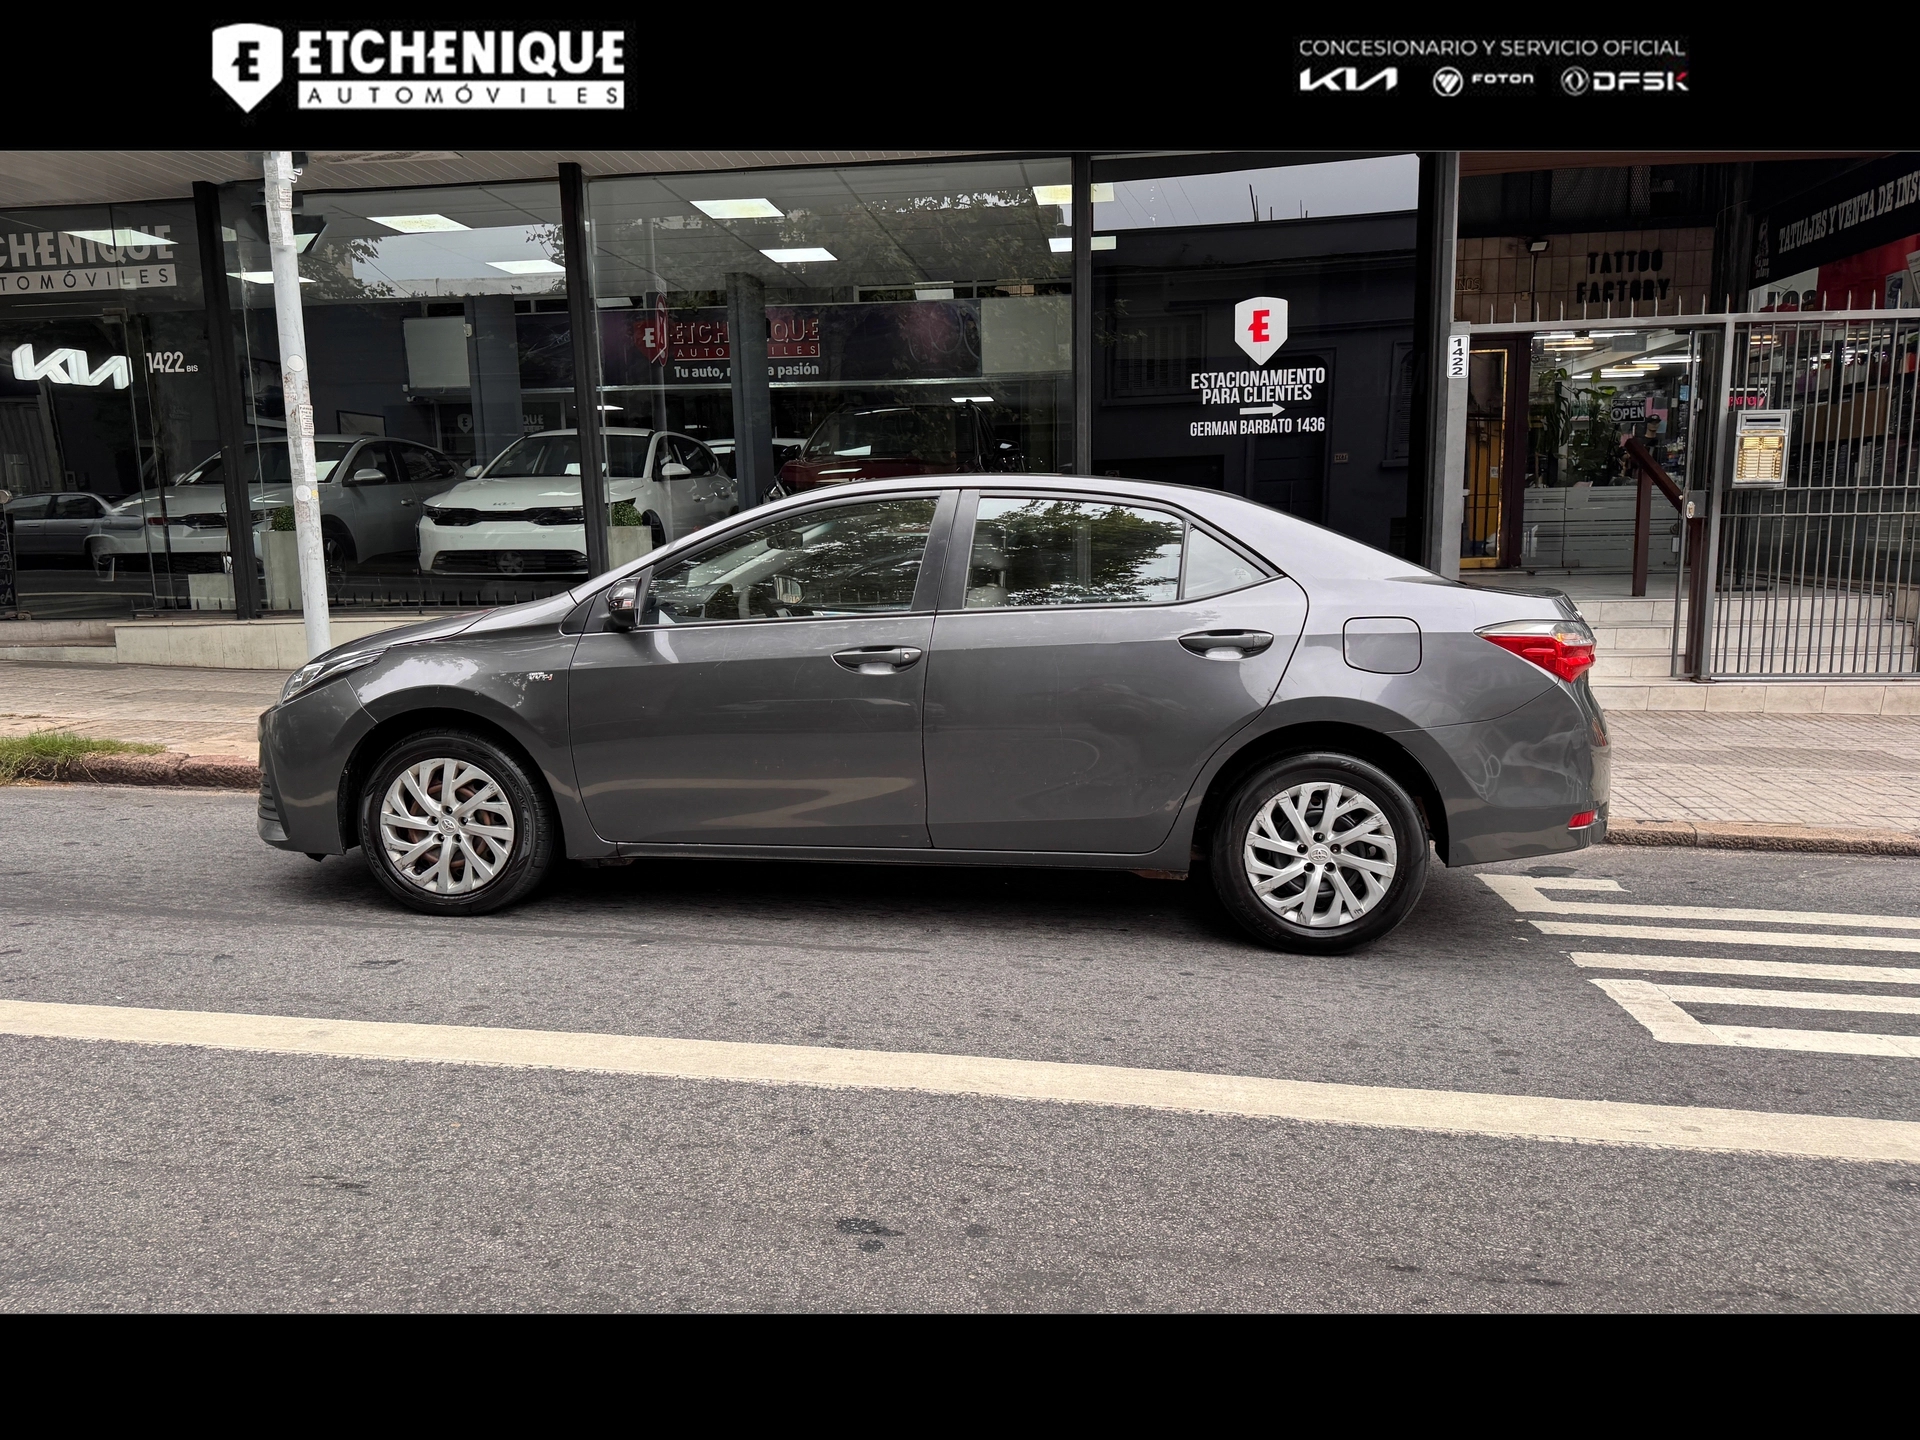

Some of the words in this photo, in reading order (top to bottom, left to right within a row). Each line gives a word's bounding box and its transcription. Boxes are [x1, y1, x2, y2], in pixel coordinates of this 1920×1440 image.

[1779, 209, 1828, 254] TATUAJES
[1828, 205, 1838, 234] Y
[1838, 189, 1875, 230] VENTA
[1877, 180, 1895, 216] DE
[1588, 249, 1664, 275] TATTOO
[1576, 278, 1671, 304] FACTORY
[146, 352, 185, 373] 1422
[186, 365, 198, 373] BIS
[677, 346, 816, 358] AUTOILES
[1452, 338, 1464, 376] 1422
[12, 343, 134, 390] KIA
[674, 366, 689, 378] Tu
[692, 366, 724, 379] auto,
[778, 363, 820, 378] pasión
[1191, 367, 1325, 389] ESTACIONAMIENTO
[1202, 387, 1240, 405] PARA
[1244, 384, 1312, 403] CLIENTES
[1611, 406, 1644, 421] OPEN
[1190, 420, 1237, 436] GERMAN
[1240, 418, 1292, 434] BARBATO
[1296, 417, 1325, 432] 1436
